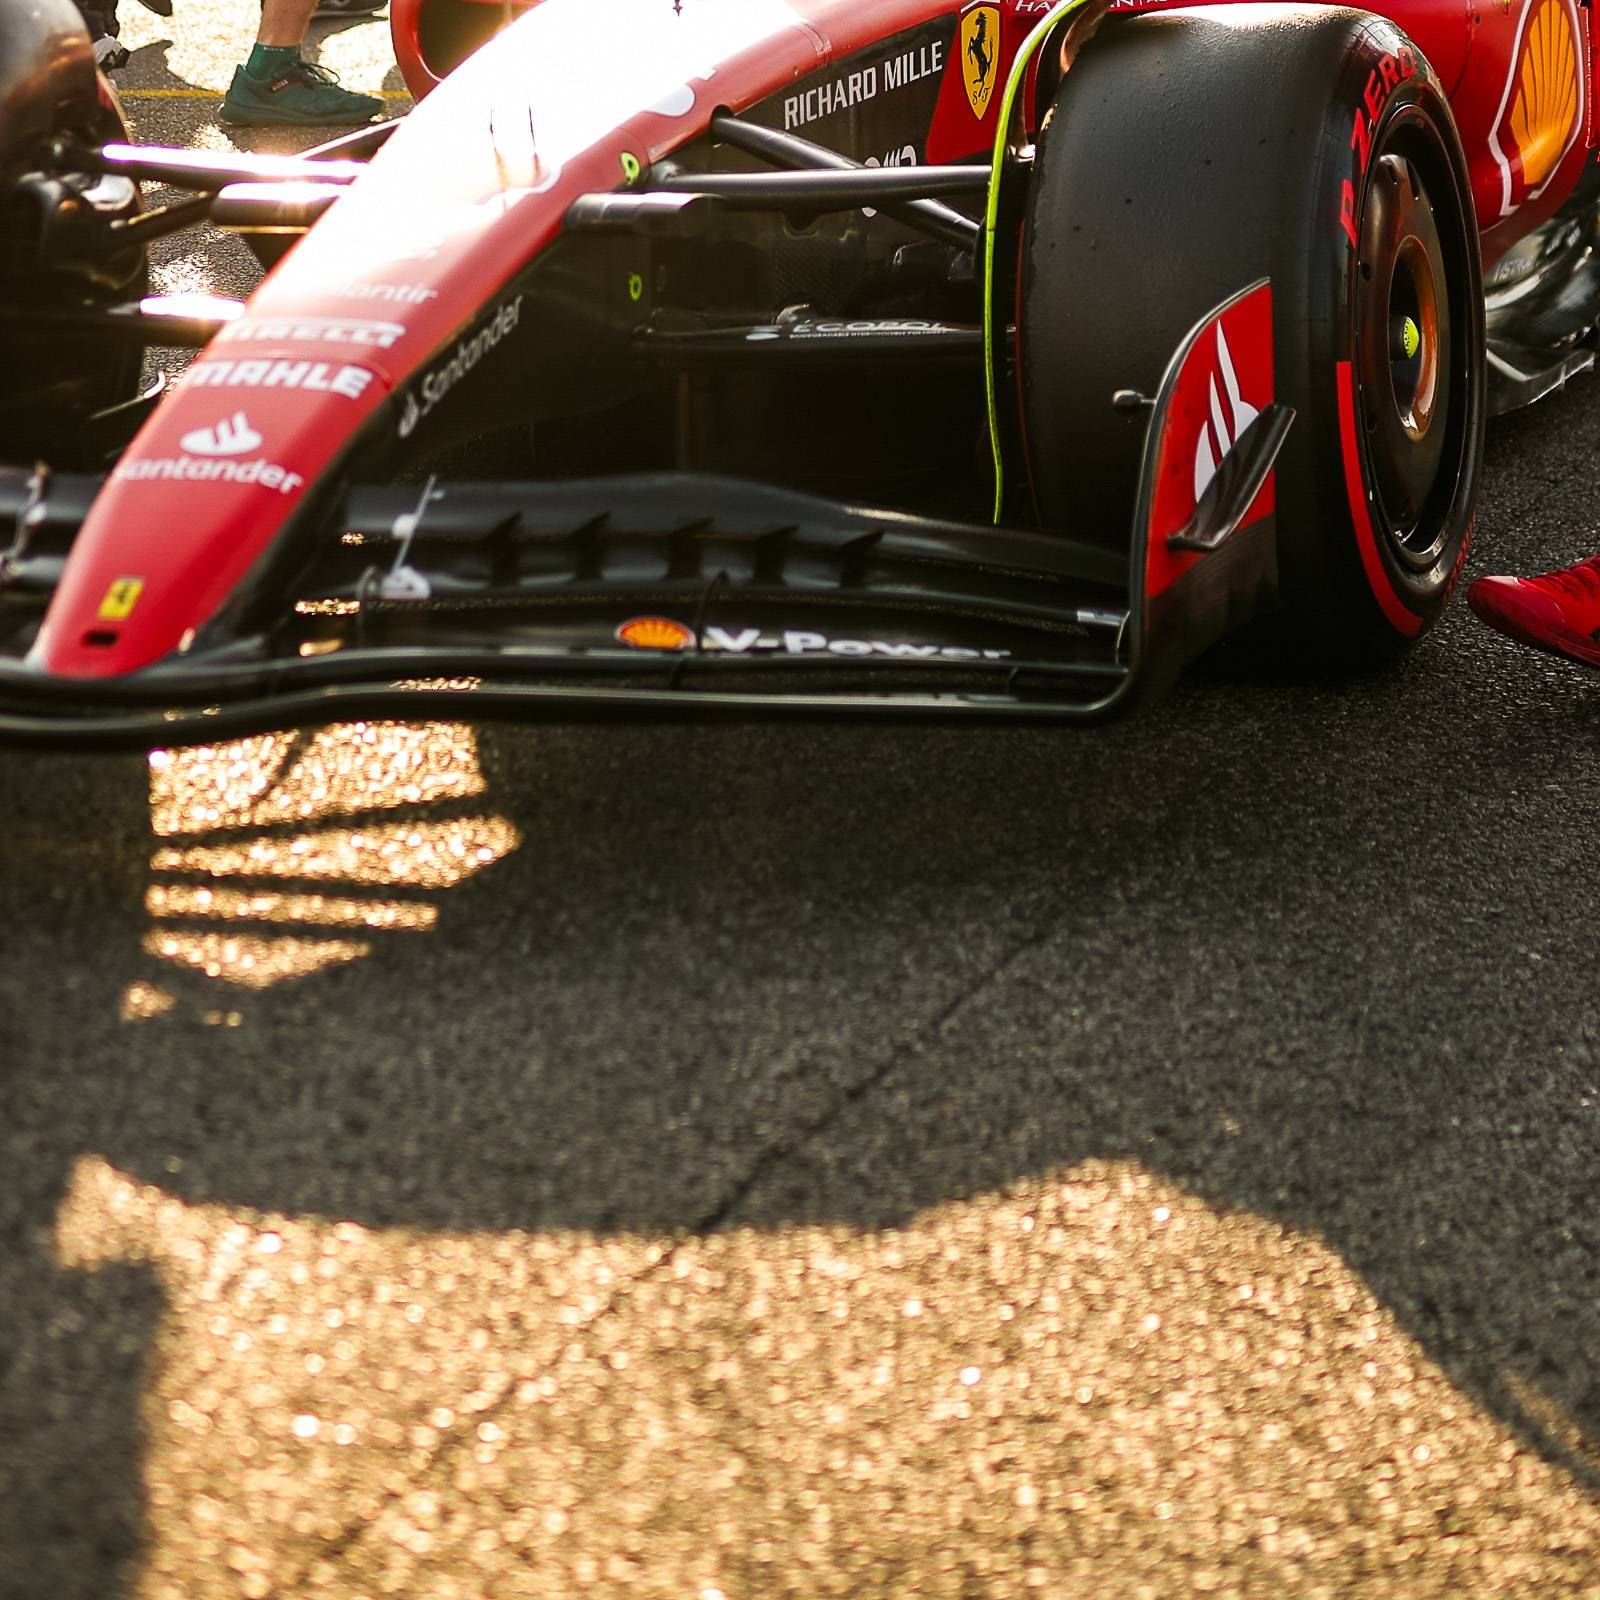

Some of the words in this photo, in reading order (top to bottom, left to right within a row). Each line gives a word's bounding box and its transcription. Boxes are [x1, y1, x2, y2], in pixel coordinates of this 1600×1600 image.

[783, 66, 877, 131] RICHARD
[884, 40, 943, 93] MILLE
[188, 358, 374, 400] MAHLE
[422, 294, 523, 413] Santander
[705, 625, 1011, 661] V-Power
